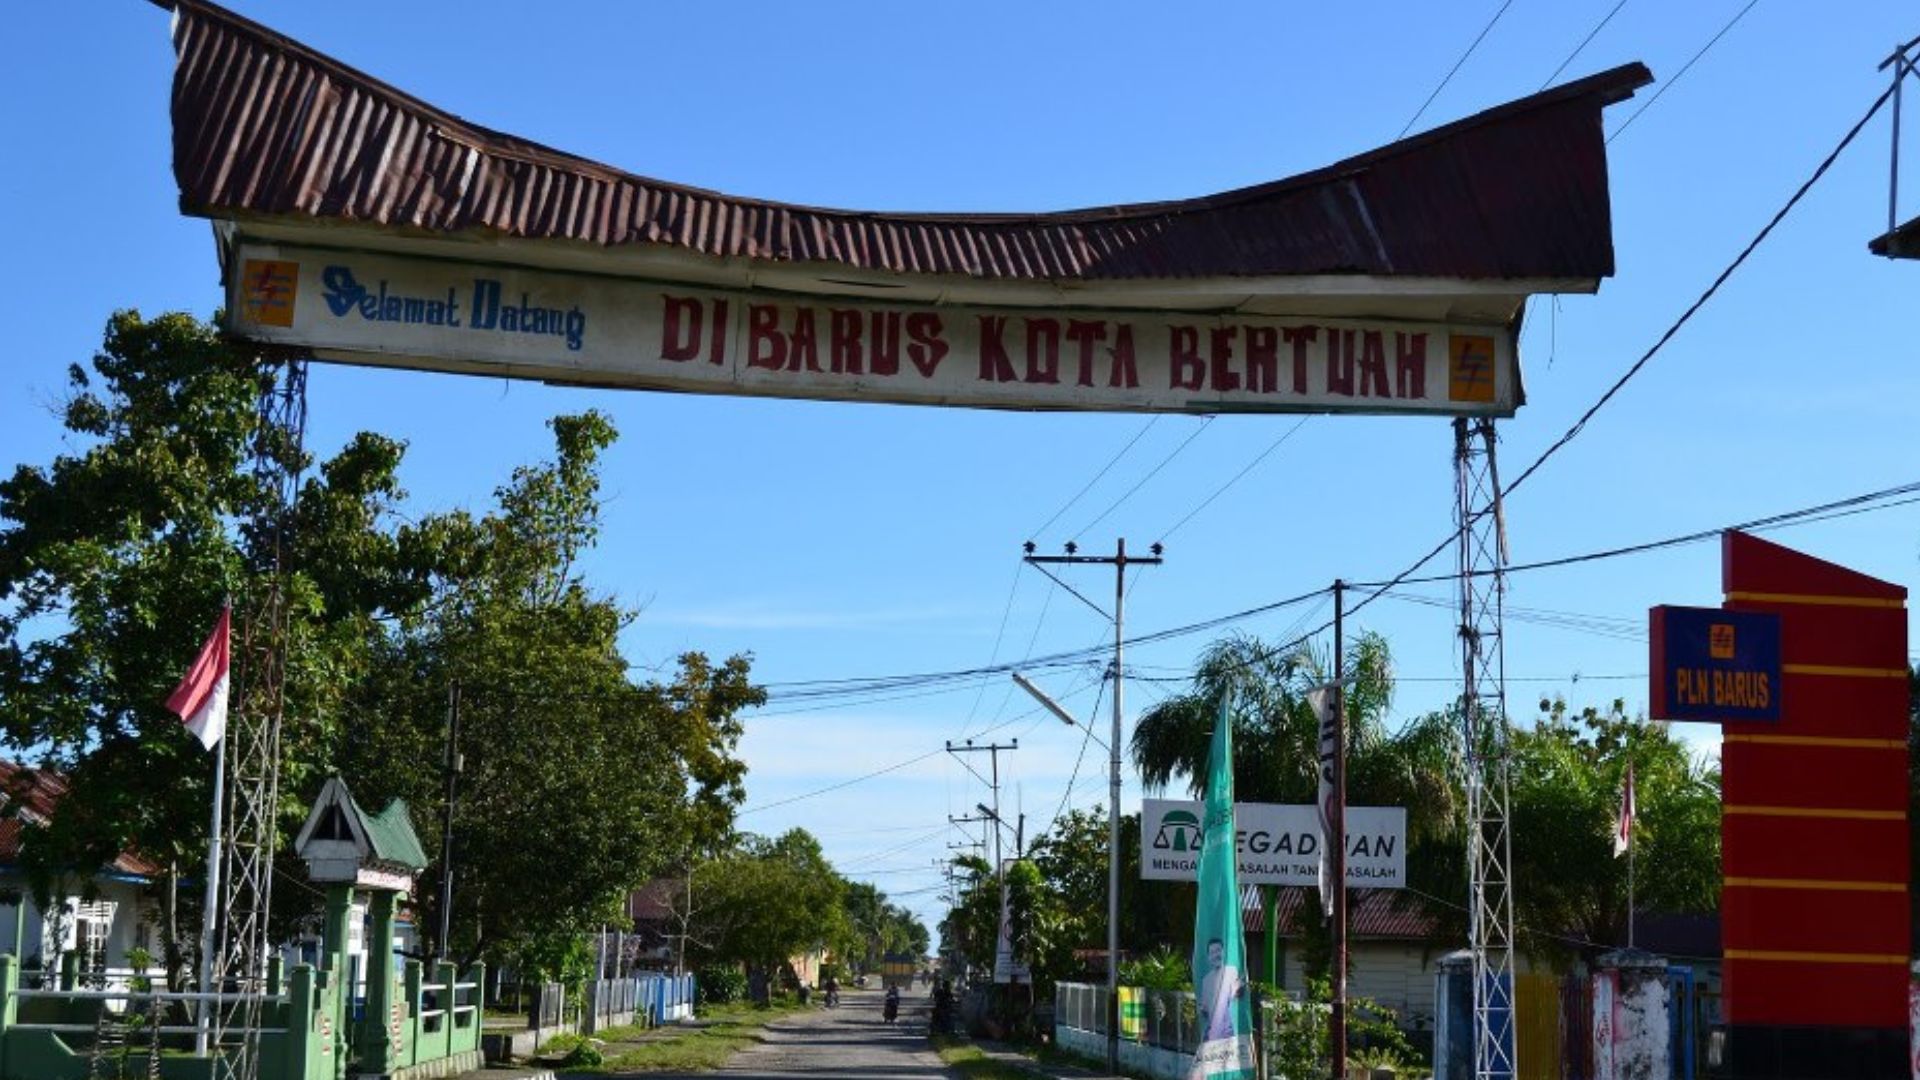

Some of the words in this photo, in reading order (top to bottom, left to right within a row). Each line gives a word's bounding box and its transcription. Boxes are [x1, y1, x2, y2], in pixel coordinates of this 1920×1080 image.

[321, 264, 460, 328] Selamat
[469, 278, 586, 351] Datang
[659, 293, 729, 367] DI
[747, 303, 950, 378] BARUS
[976, 314, 1140, 388] KOTA
[1166, 322, 1430, 400] BERTUAH
[1676, 667, 1709, 706] PLN
[1713, 669, 1771, 709] BARUS
[1236, 830, 1396, 858] EGADAN
[1239, 861, 1288, 875] ASALAH
[1293, 863, 1319, 877] TAN
[1346, 866, 1396, 879] ASALAH
